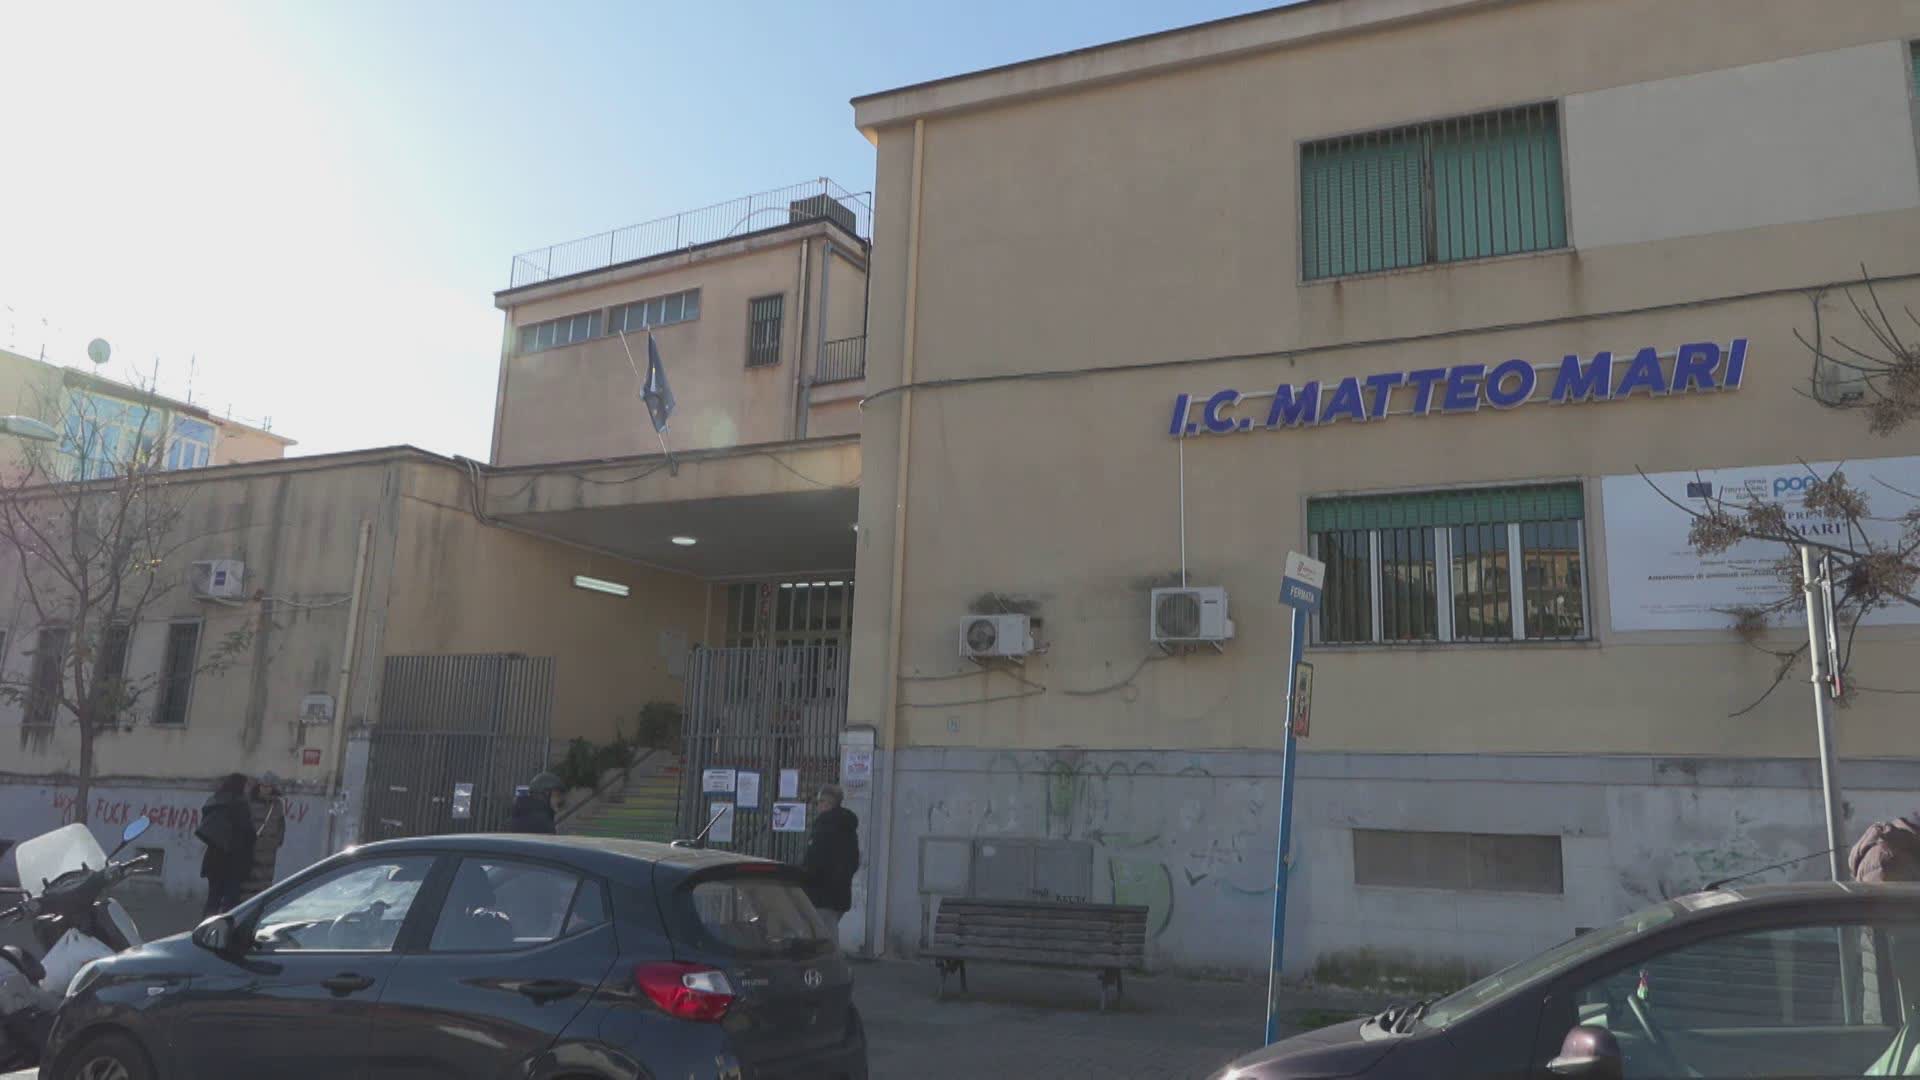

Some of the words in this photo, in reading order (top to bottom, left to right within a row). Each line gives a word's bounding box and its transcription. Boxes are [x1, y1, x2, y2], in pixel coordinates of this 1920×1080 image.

[1169, 389, 1254, 438] I.C.
[1266, 358, 1538, 431] MATTEO
[1550, 338, 1749, 406] MARI
[96, 798, 131, 824] FUCK
